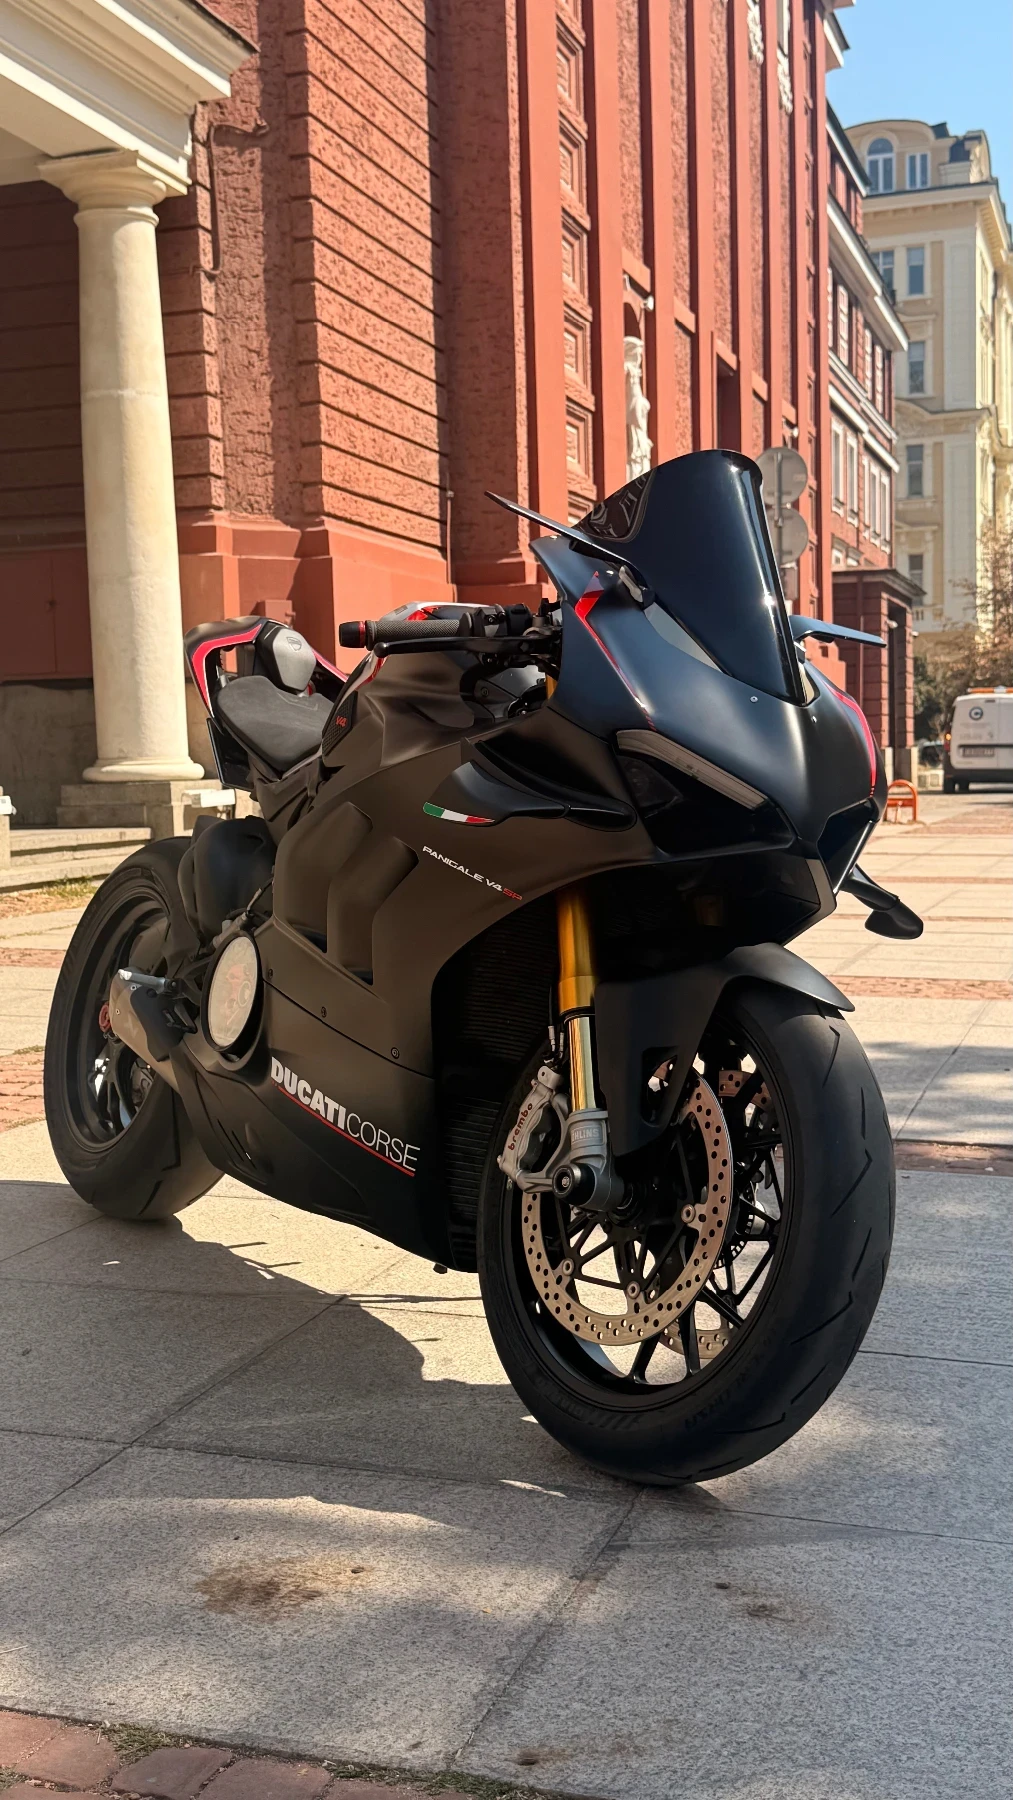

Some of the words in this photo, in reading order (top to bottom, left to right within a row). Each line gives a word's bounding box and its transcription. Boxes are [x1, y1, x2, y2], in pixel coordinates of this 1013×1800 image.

[422, 845, 485, 883] PANIGALE
[270, 1056, 347, 1130] DUCATI
[346, 1112, 421, 1172] CORSE
[507, 1102, 533, 1151] brembo
[572, 1128, 601, 1141] HLINS
